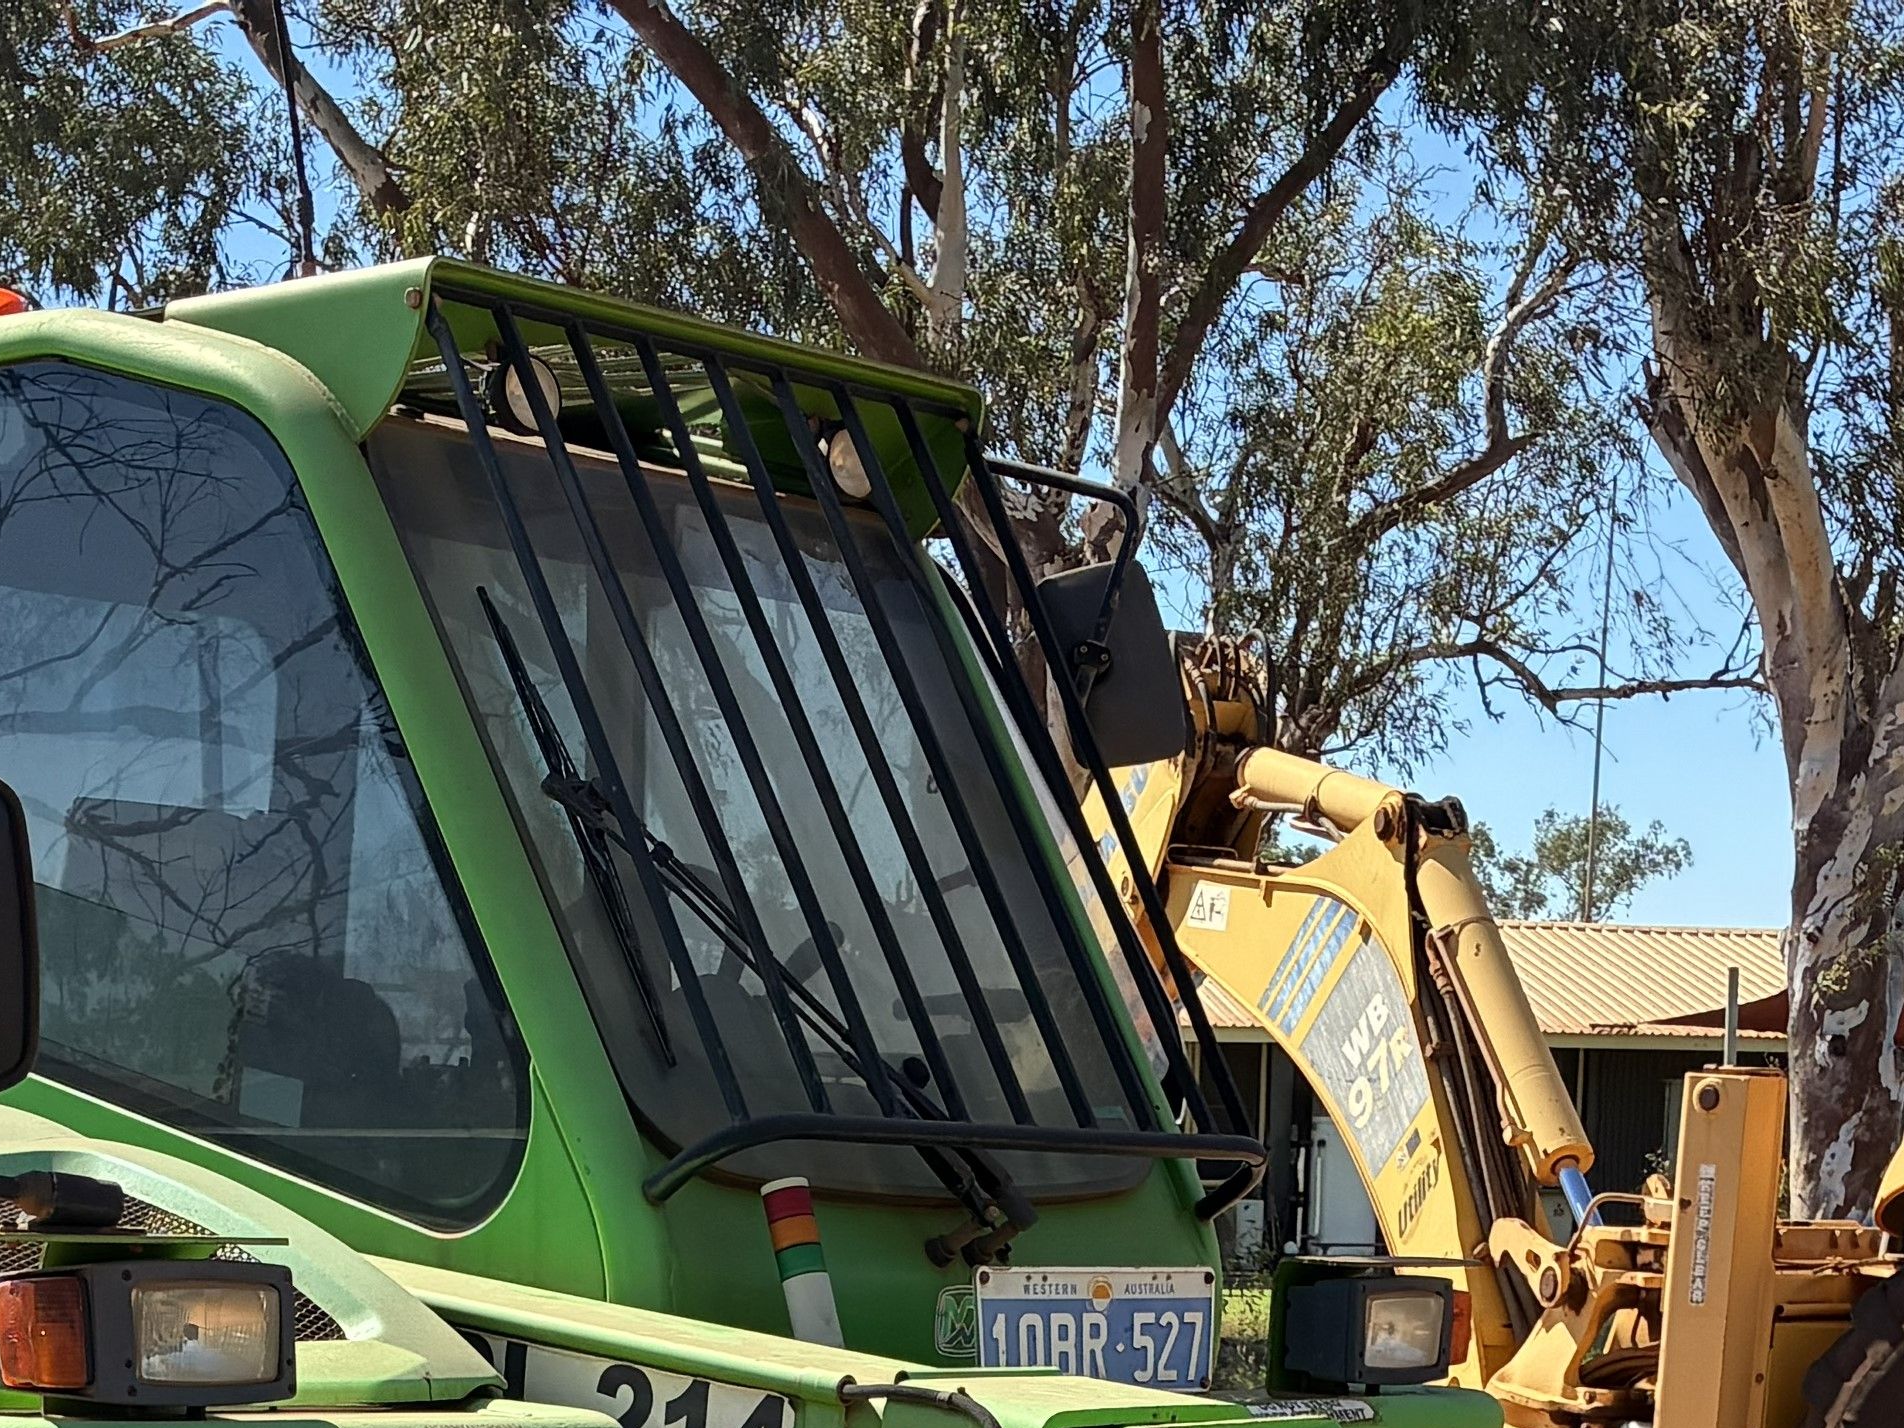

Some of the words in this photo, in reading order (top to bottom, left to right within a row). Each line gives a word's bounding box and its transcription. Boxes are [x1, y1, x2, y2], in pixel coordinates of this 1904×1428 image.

[1340, 991, 1390, 1071] WB
[1348, 1025, 1414, 1129] 97R
[1397, 1157, 1441, 1239] Utility
[1022, 1283, 1078, 1296] WESTERN
[1124, 1282, 1176, 1296] AUSTRALIA
